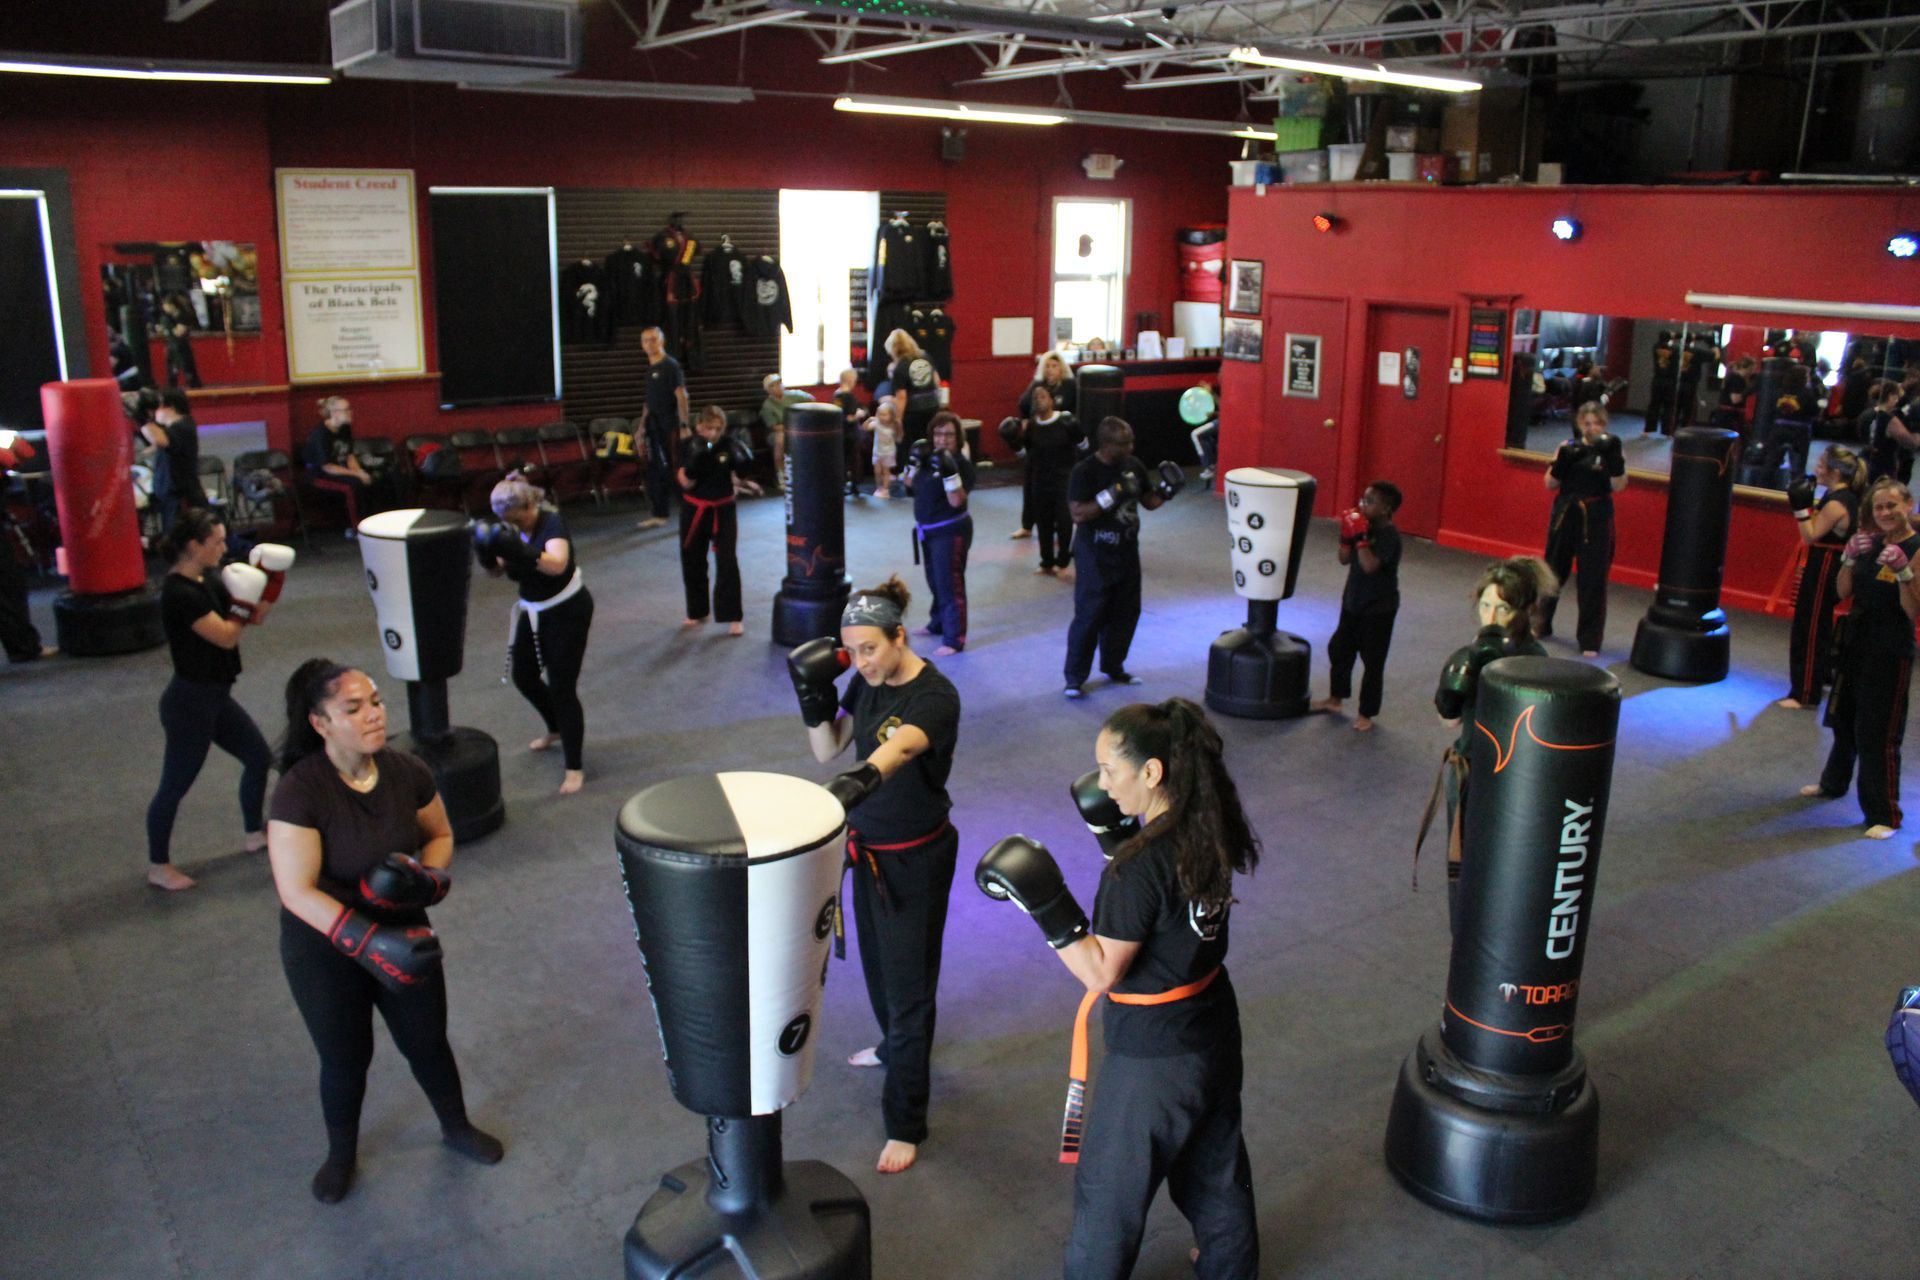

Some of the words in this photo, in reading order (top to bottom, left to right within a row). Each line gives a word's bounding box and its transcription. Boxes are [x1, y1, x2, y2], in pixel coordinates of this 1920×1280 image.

[293, 178, 352, 189] Student
[355, 178, 397, 190] Creed
[303, 285, 328, 294] The
[308, 300, 323, 308] of
[327, 297, 365, 307] Black
[371, 296, 397, 306] Belt
[784, 454, 793, 525] CENTURY
[1545, 798, 1594, 960] CENTURY
[821, 904, 834, 931] 3
[791, 1021, 807, 1049] 7
